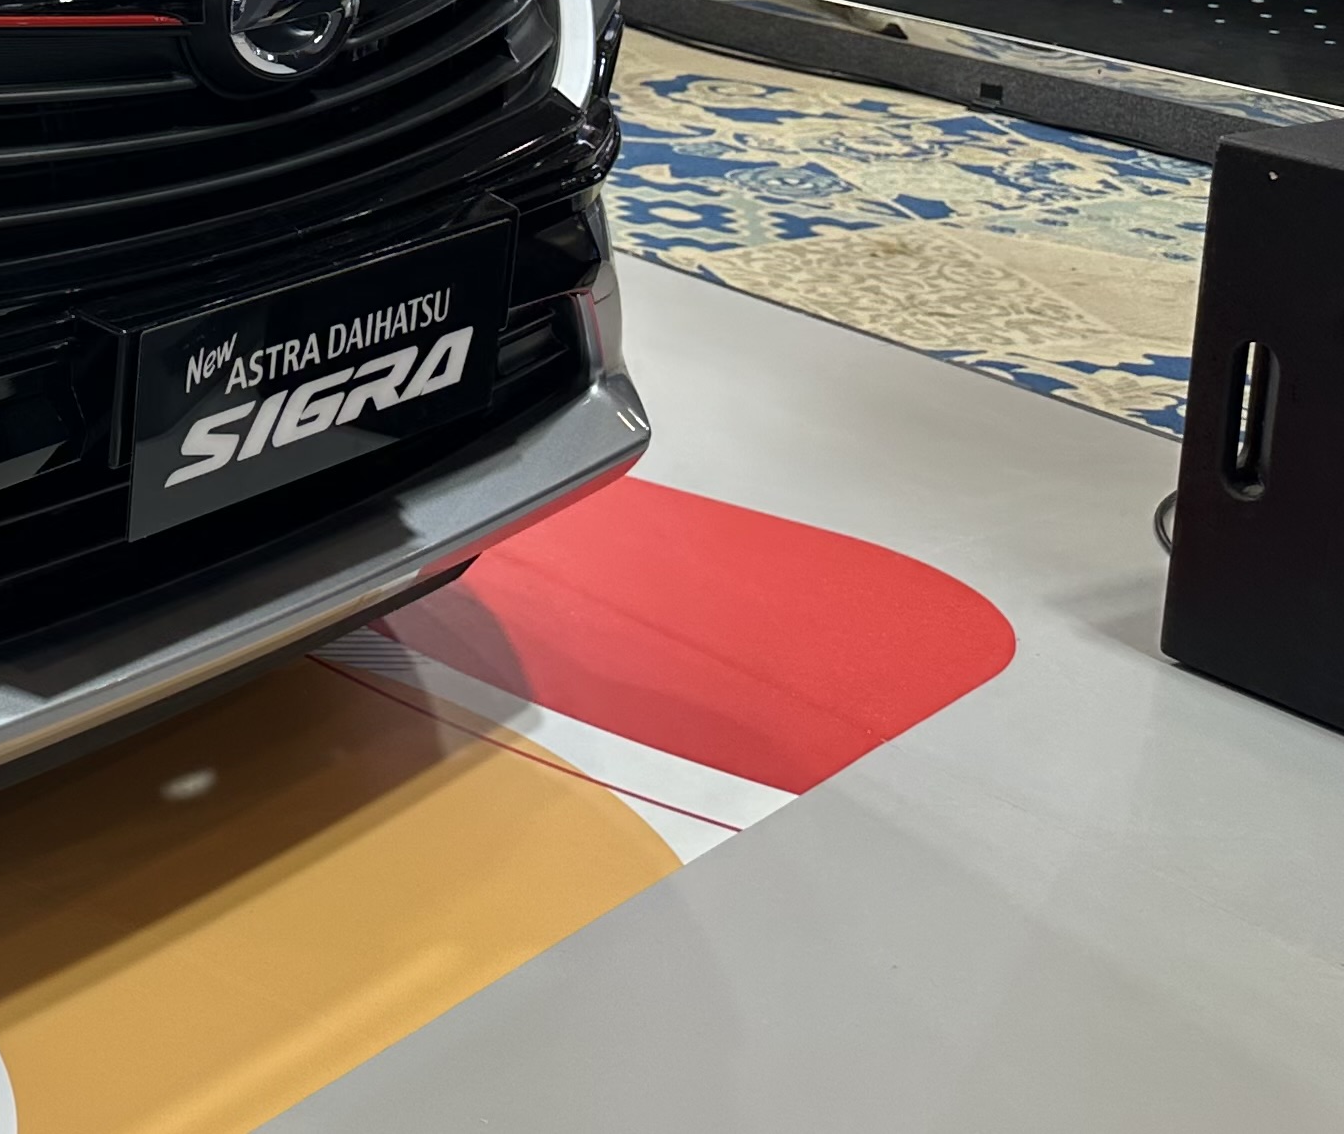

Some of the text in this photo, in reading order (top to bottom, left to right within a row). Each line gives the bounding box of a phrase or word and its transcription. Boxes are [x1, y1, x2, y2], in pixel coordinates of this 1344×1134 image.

[164, 326, 475, 489] SIGRA
[185, 287, 452, 396] New ASTRA DAIHATSU
